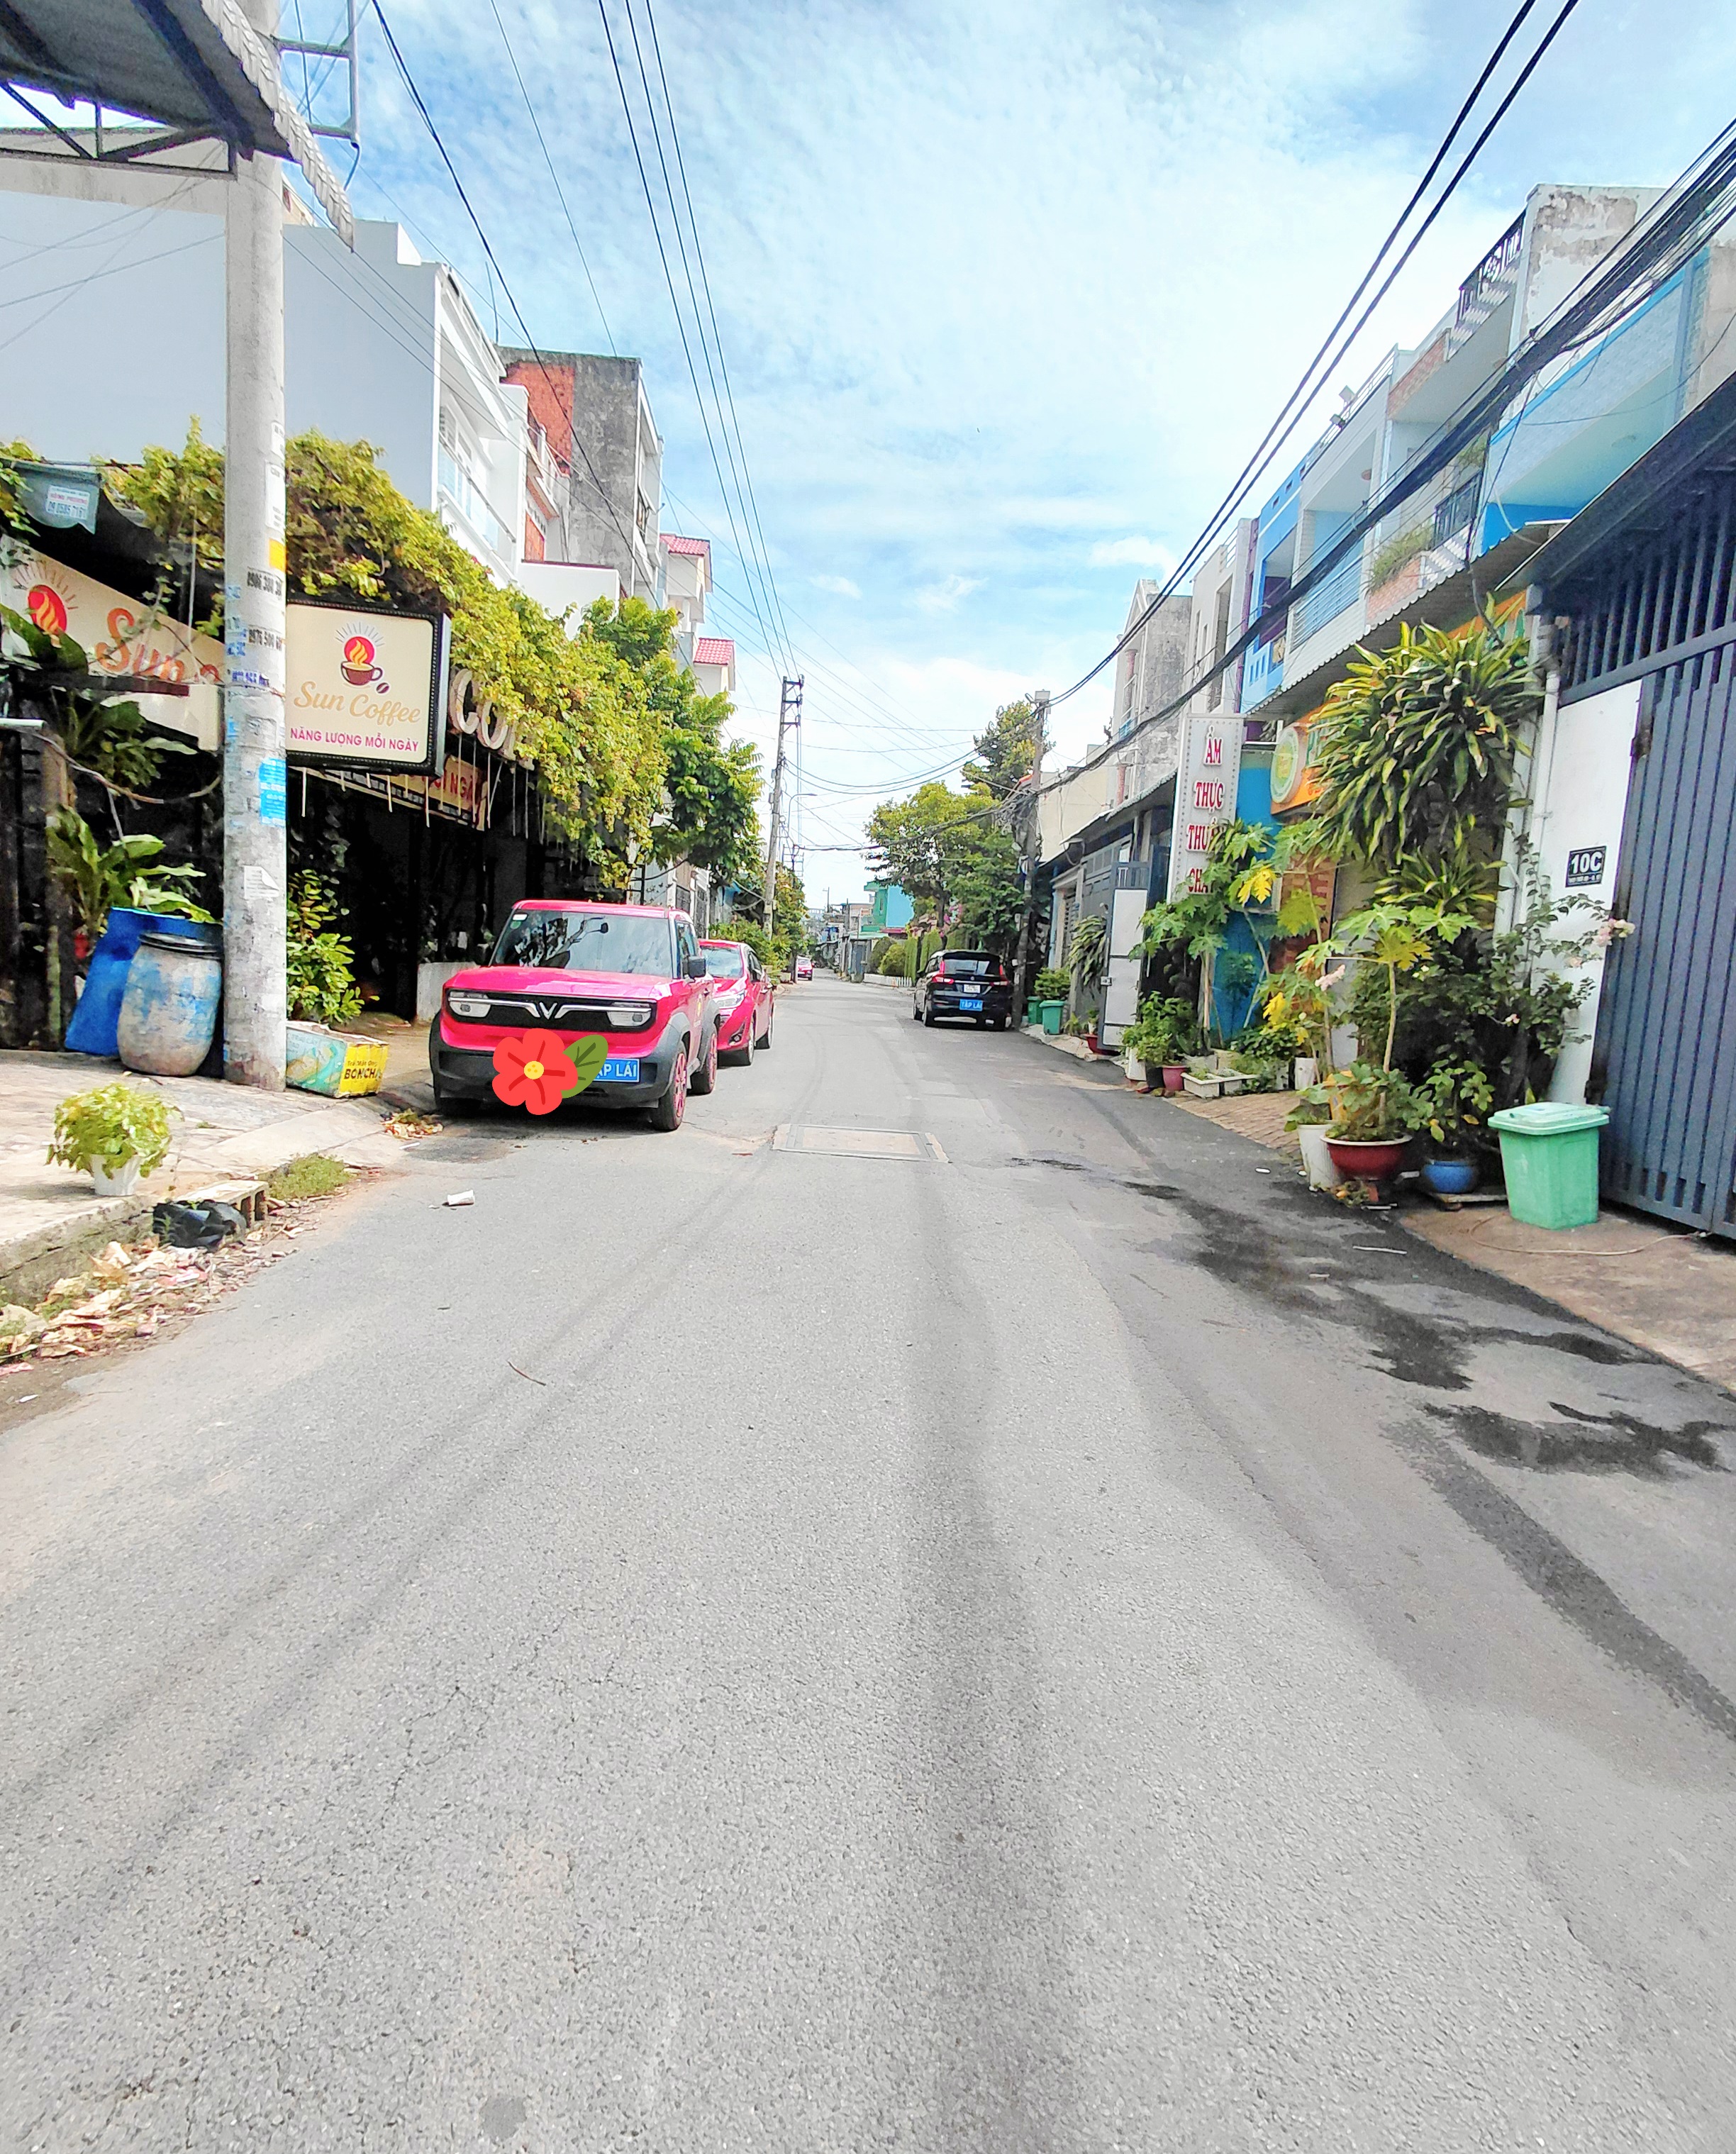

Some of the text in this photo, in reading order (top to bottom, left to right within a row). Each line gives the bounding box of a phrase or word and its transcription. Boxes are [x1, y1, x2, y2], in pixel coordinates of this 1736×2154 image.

[294, 681, 421, 726] Sun Coffee
[291, 726, 419, 753] NĂNG LƯỢNG MỖI NGÀY
[1196, 777, 1224, 813] THỰC
[1571, 851, 1603, 874] 10C
[616, 1061, 637, 1077] LÁI
